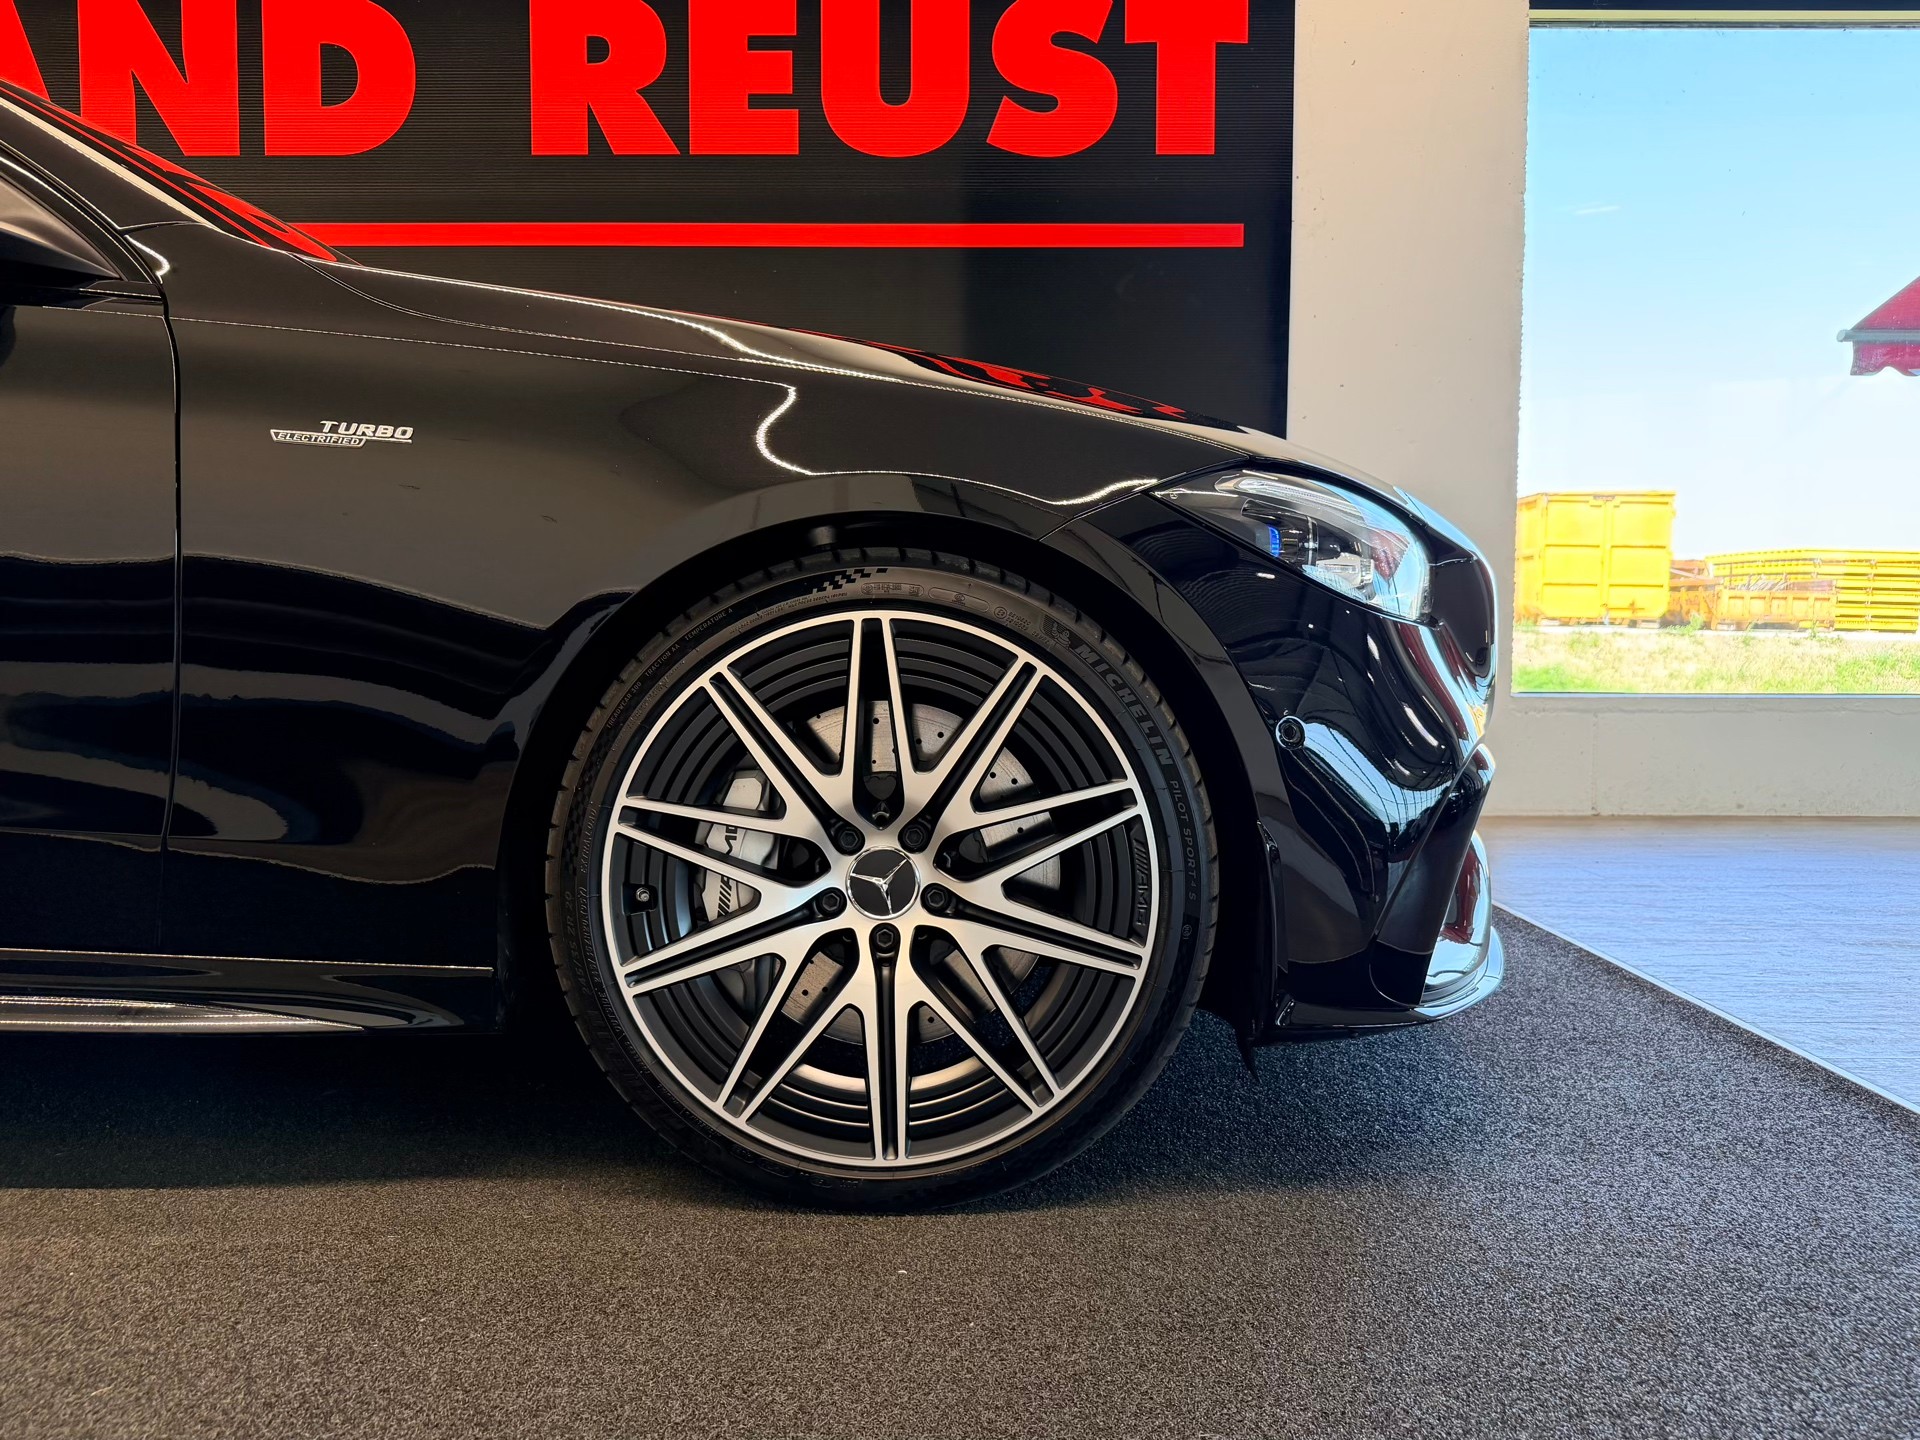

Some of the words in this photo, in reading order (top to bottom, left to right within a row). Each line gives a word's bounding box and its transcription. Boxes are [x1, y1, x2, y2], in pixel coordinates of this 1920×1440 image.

[530, 0, 1249, 157] REUST
[277, 432, 360, 445] ELECTRIFIED
[319, 420, 414, 439] TURBO
[644, 649, 671, 677] TRACTION
[1074, 642, 1173, 767] MICHELIN
[1169, 778, 1189, 822] PILOT
[1183, 826, 1196, 879] SPORT
[564, 890, 572, 911] 20
[1188, 890, 1196, 900] S
[565, 914, 575, 938] ZR
[568, 939, 591, 996] 245/35
